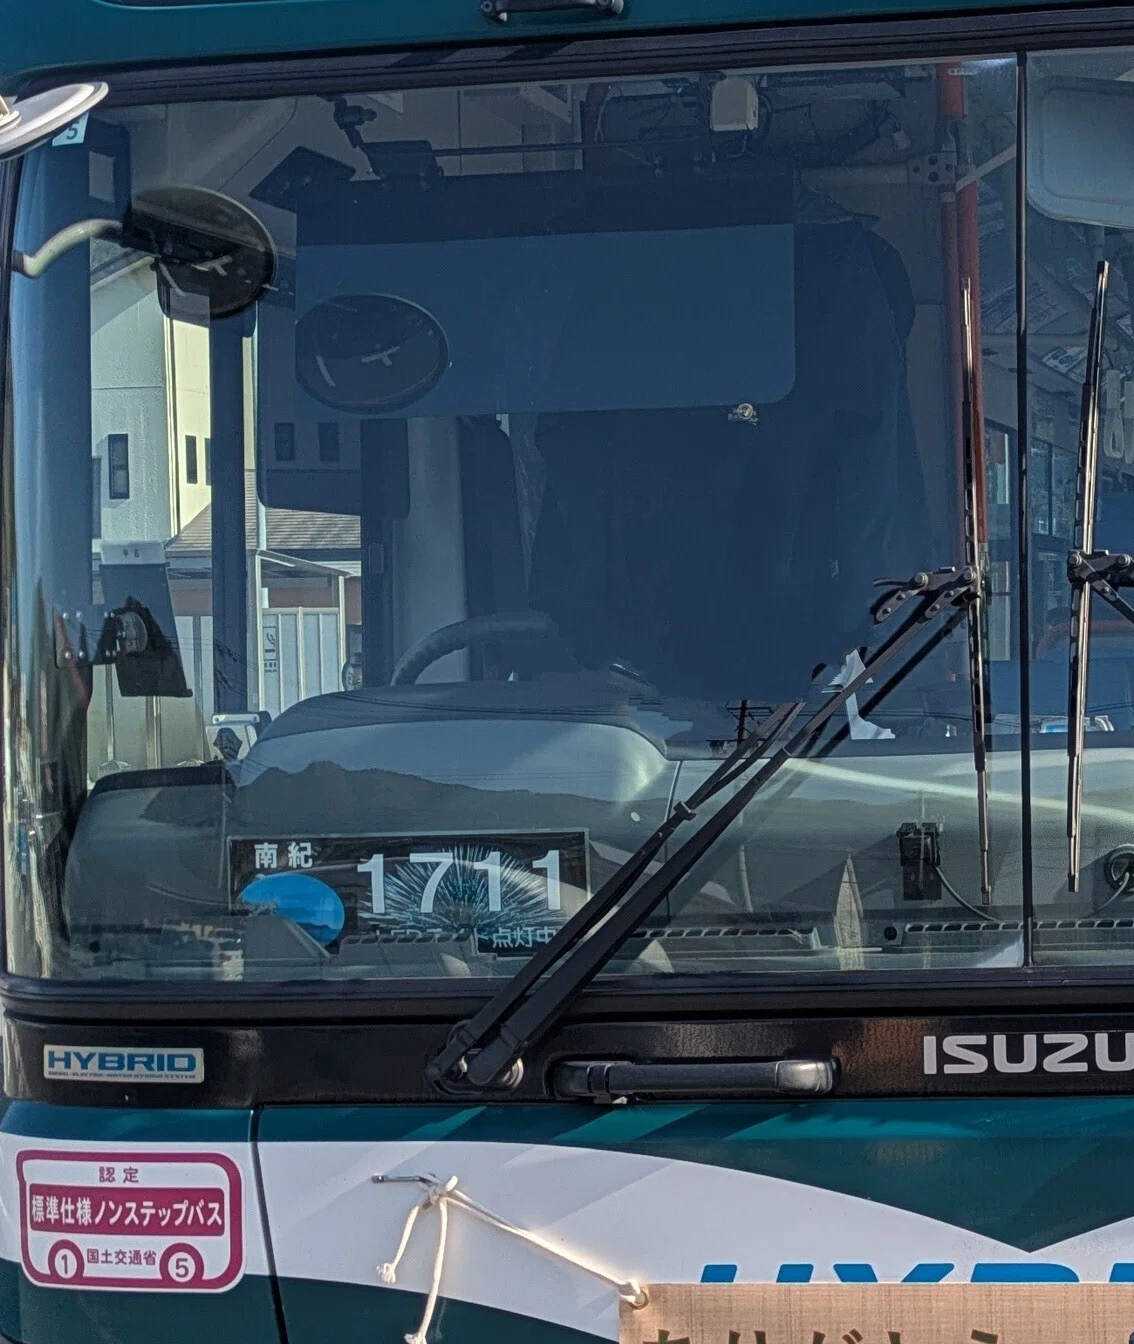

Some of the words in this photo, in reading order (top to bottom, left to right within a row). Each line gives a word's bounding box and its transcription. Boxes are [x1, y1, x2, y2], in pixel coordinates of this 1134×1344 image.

[254, 842, 313, 869] 南紀
[357, 850, 561, 914] 1711
[48, 1051, 197, 1072] HYBRID
[99, 1167, 139, 1183] 認定
[31, 1194, 222, 1226] 標準仕様ノンステップバス
[60, 1254, 69, 1275] 1
[87, 1249, 157, 1266] 国土交通省
[175, 1257, 189, 1278] 5
